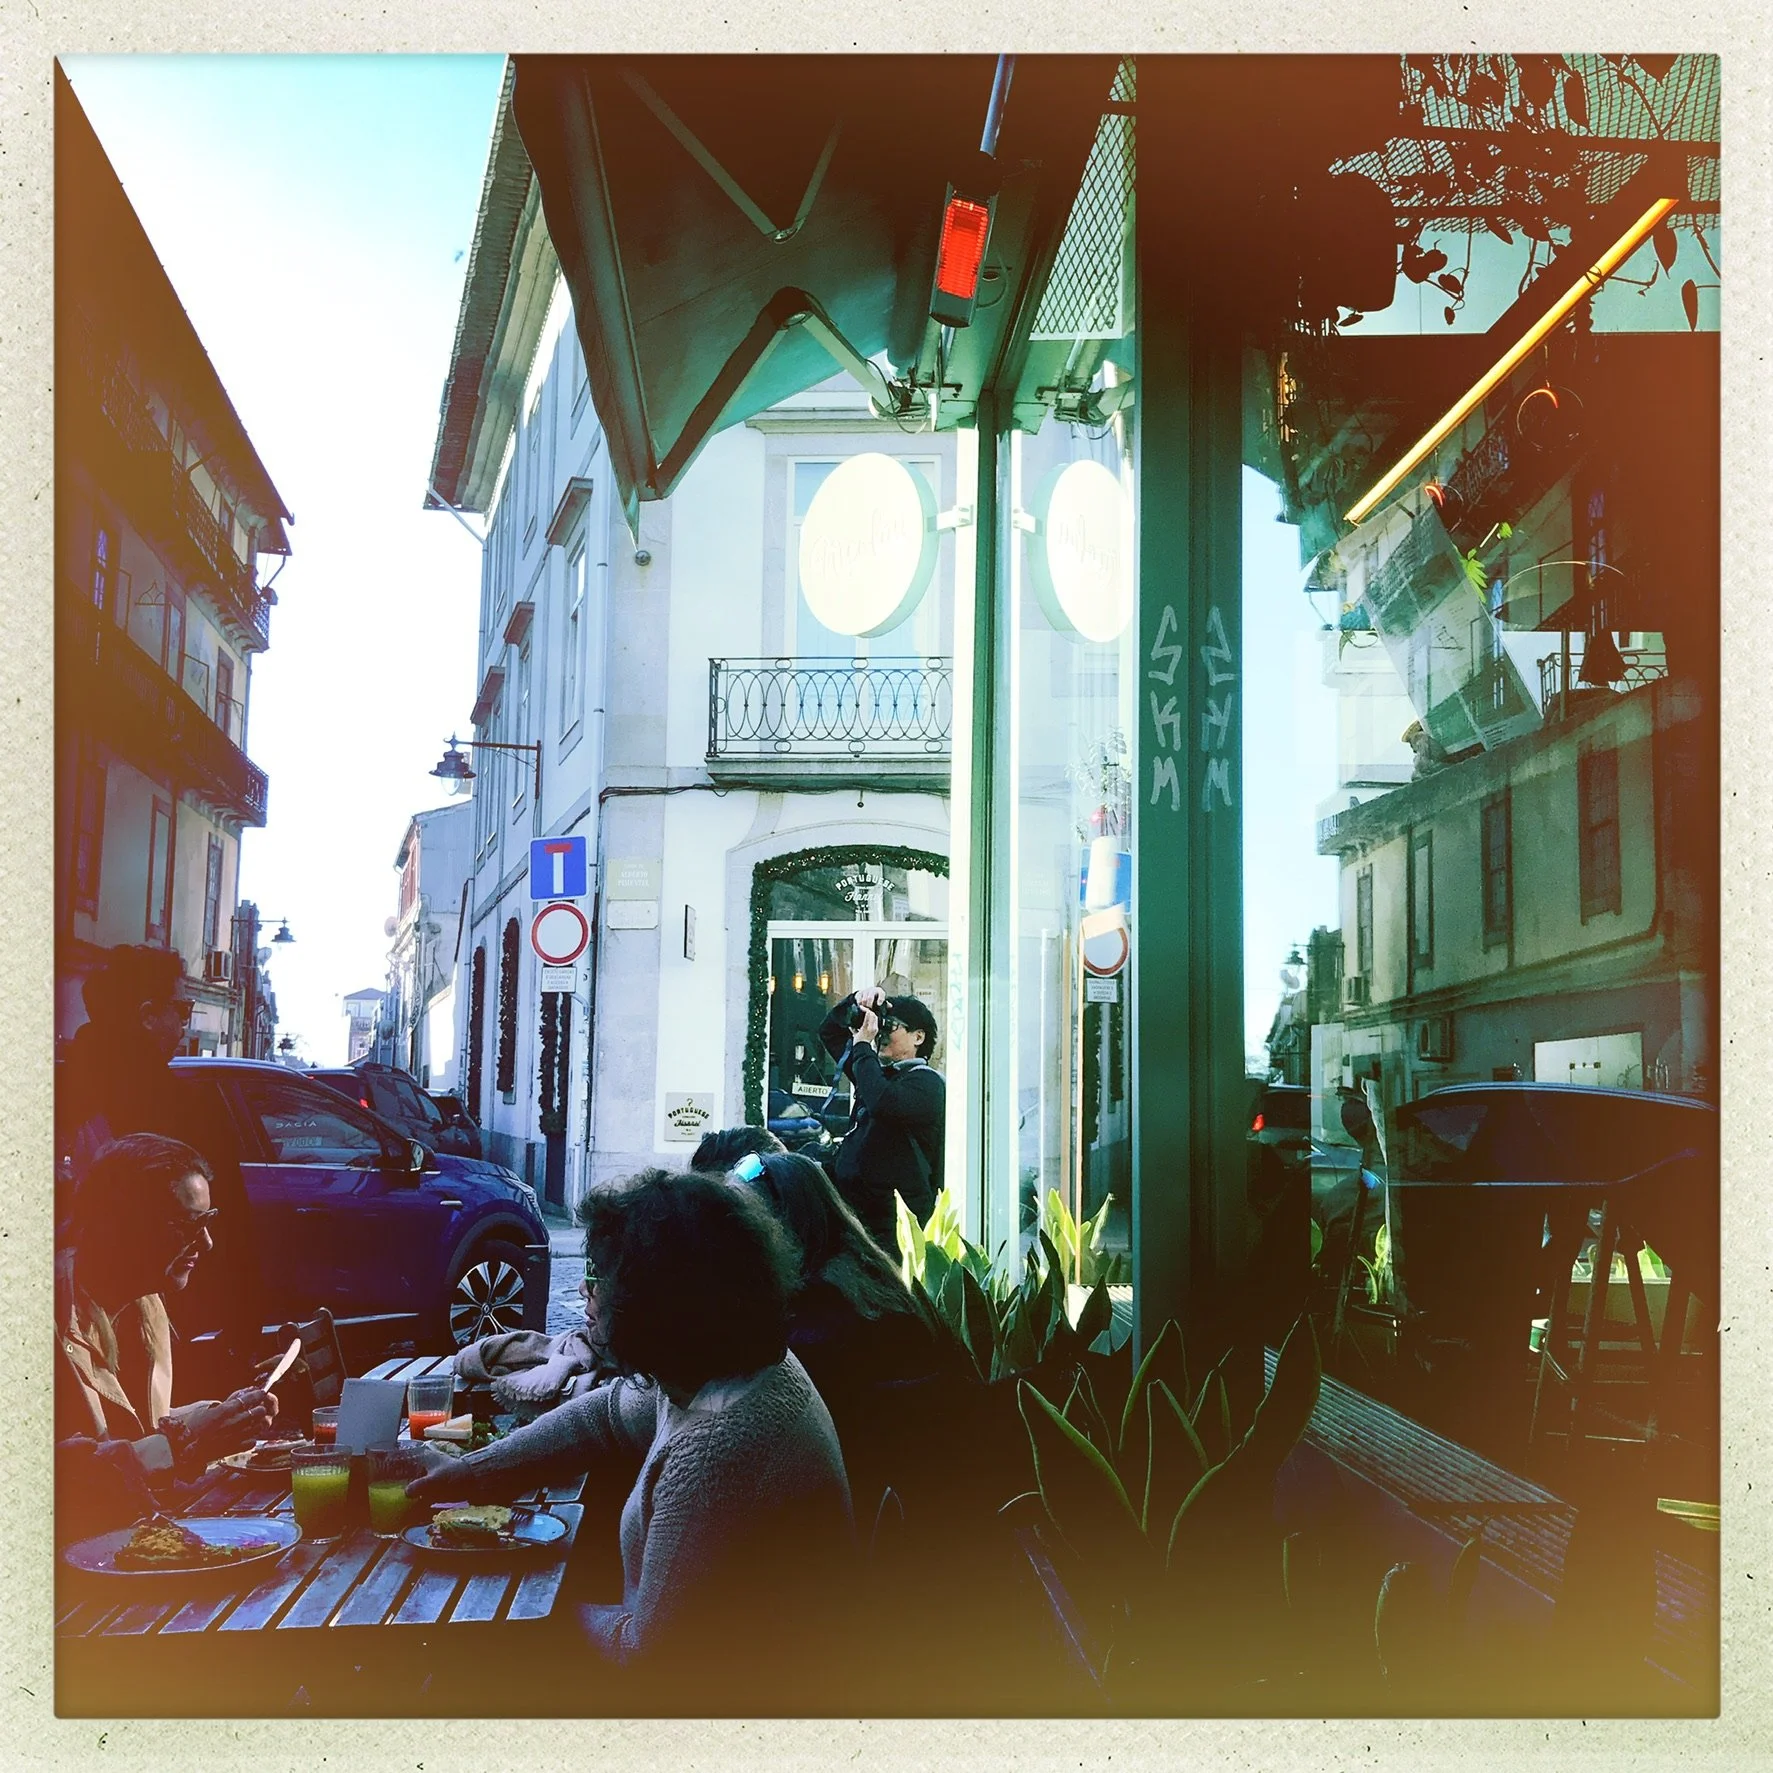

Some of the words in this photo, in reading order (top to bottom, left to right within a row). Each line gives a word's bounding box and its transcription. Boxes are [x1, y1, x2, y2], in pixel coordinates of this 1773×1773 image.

[836, 874, 895, 891] PORTUGUESE
[798, 1086, 828, 1095] ABERTO
[668, 1107, 710, 1119] PORTUGUESE
[275, 1121, 317, 1129] DACIA
